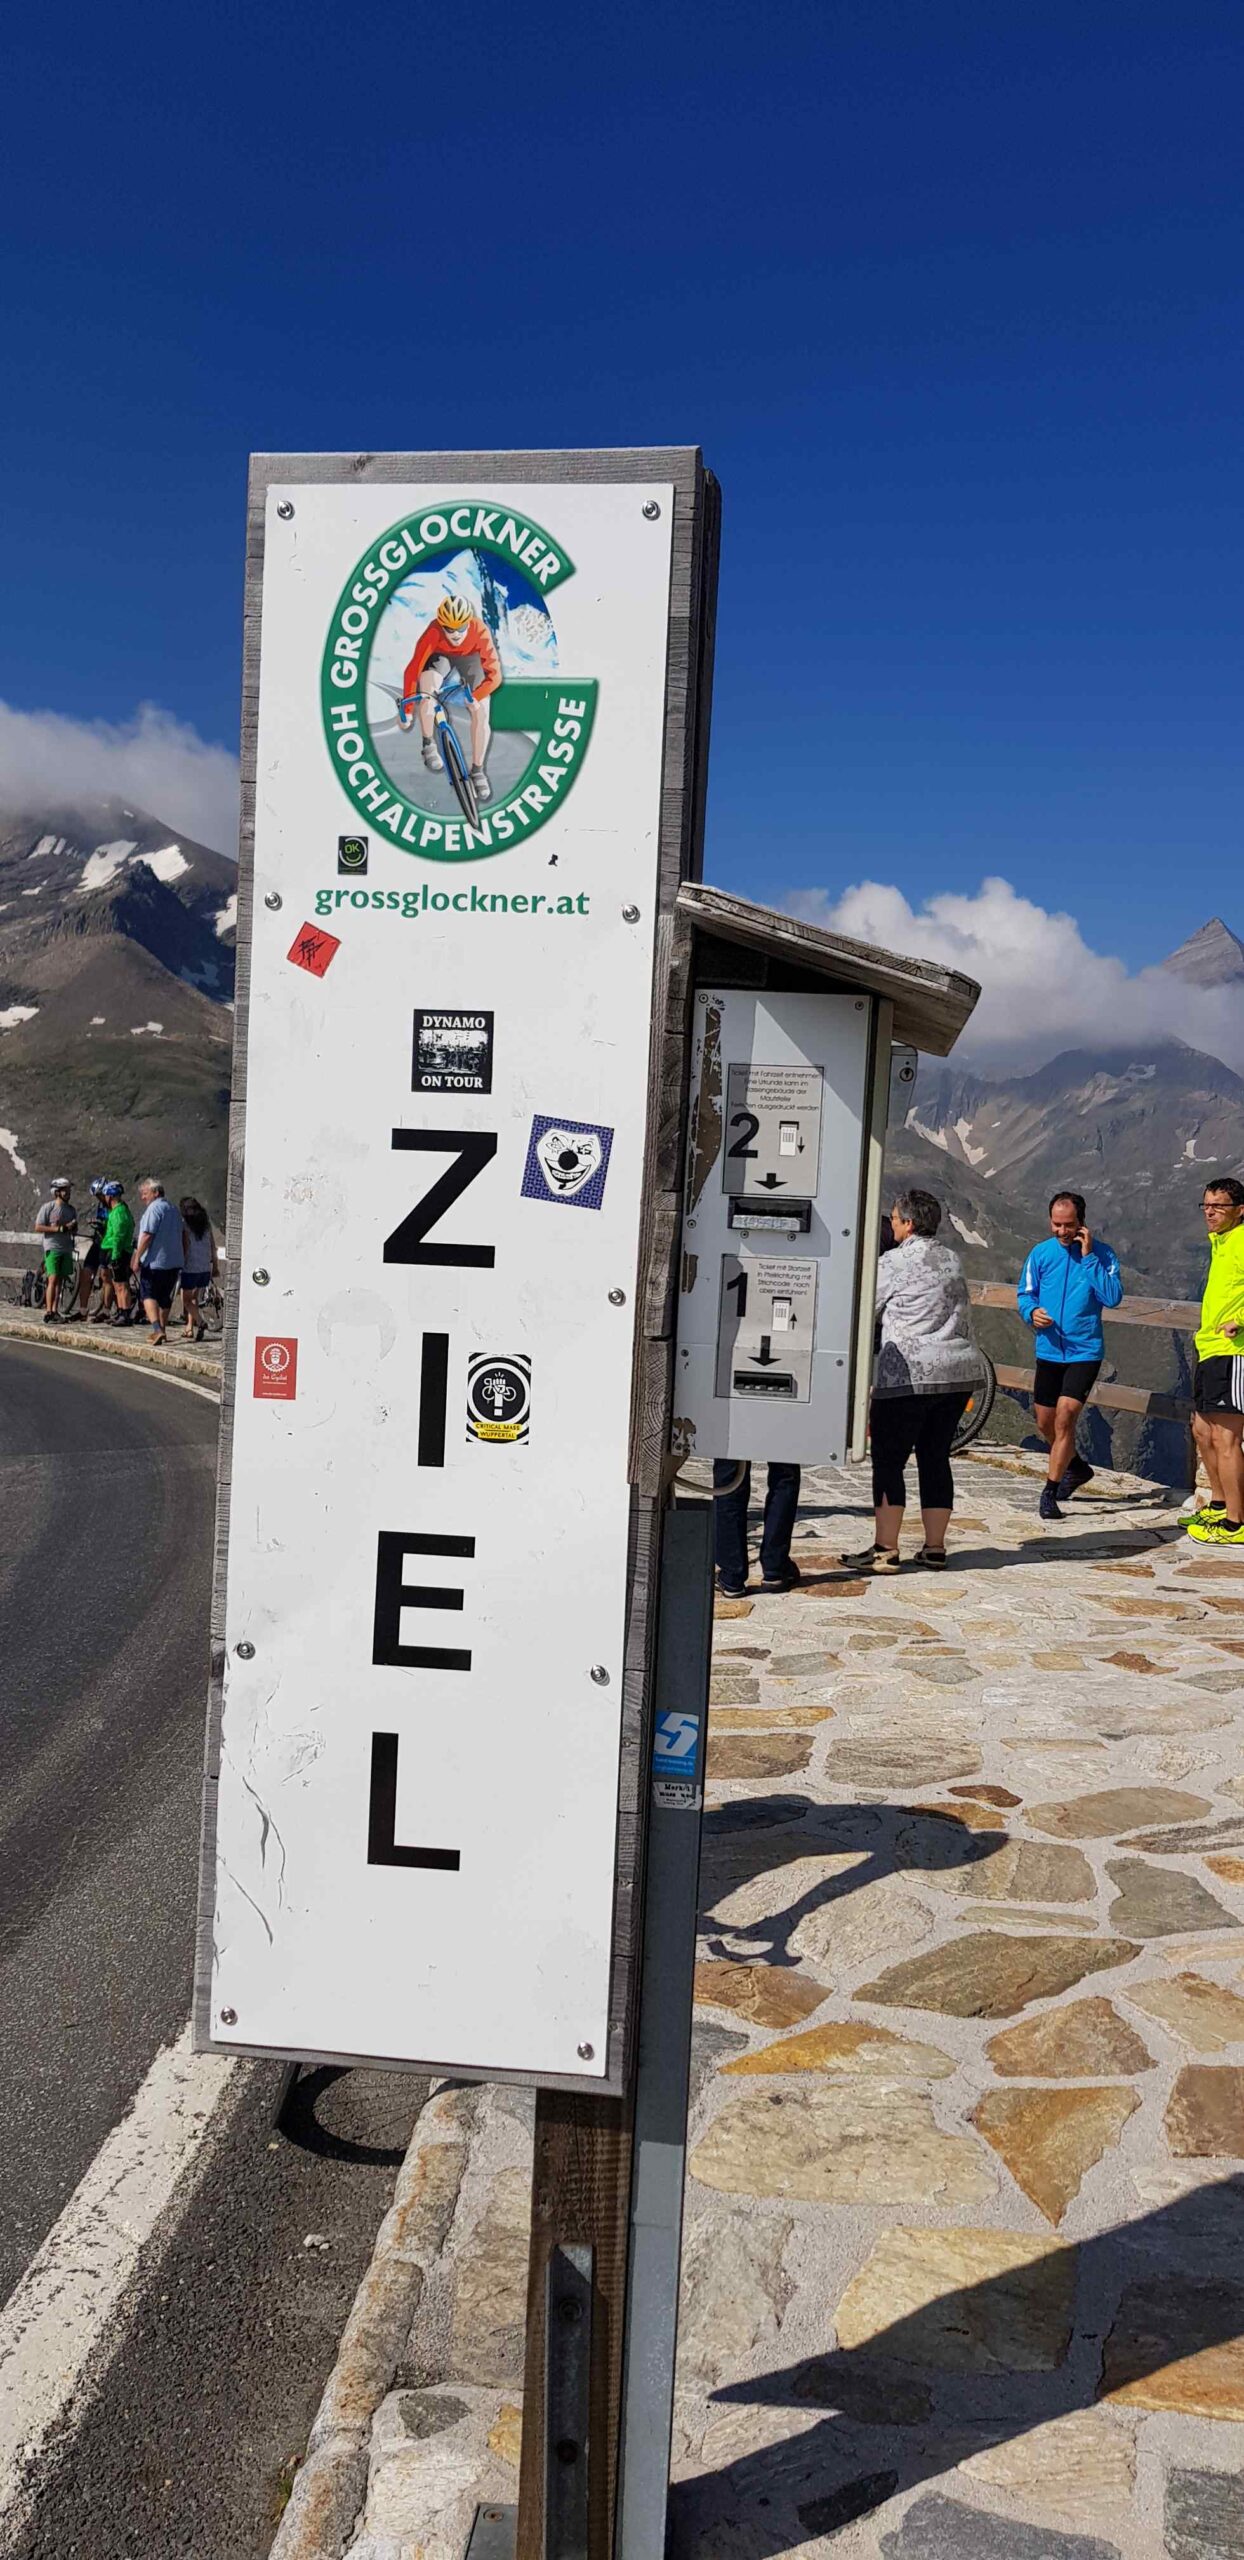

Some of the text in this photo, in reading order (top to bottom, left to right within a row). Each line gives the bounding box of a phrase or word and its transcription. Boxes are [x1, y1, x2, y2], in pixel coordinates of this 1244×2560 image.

[329, 507, 561, 689] GROSSGLOCKNER
[330, 697, 586, 852] HOCHALPENSTRASSE
[344, 843, 361, 854] OK
[314, 884, 591, 918] grossglockner.at
[422, 1015, 486, 1029] DYNAMO
[421, 1075, 484, 1089] ON TOUR
[757, 1103, 796, 1111] ausgedruckt
[727, 1112, 760, 1159] 2
[726, 1272, 748, 1317] 1
[475, 1423, 502, 1431] CRITICAL
[367, 1127, 498, 1872] ZIEL
